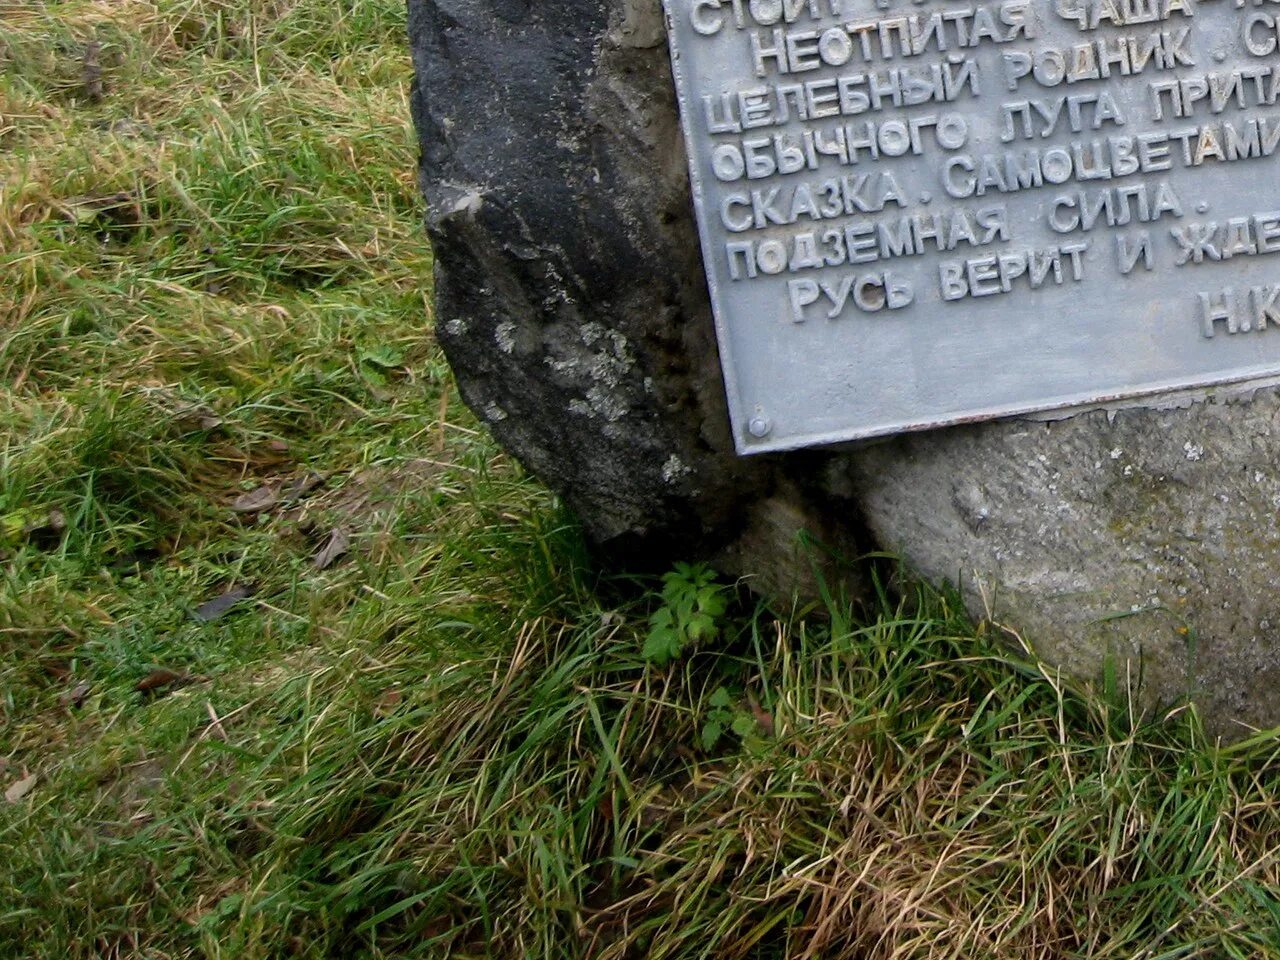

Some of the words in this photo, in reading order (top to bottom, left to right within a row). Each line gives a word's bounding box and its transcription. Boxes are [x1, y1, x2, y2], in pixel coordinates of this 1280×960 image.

[702, 53, 982, 135] ЦЕЛЕБНЫЙ
[711, 111, 970, 182] ОБЫЧНОГО
[1000, 90, 1126, 143] ЛУГА
[725, 205, 1011, 282] ПОДЗЕМНАЯ
[786, 270, 915, 323] РУСЬ
[938, 242, 1088, 303] ВЕРИТ
[1115, 231, 1156, 276] И
